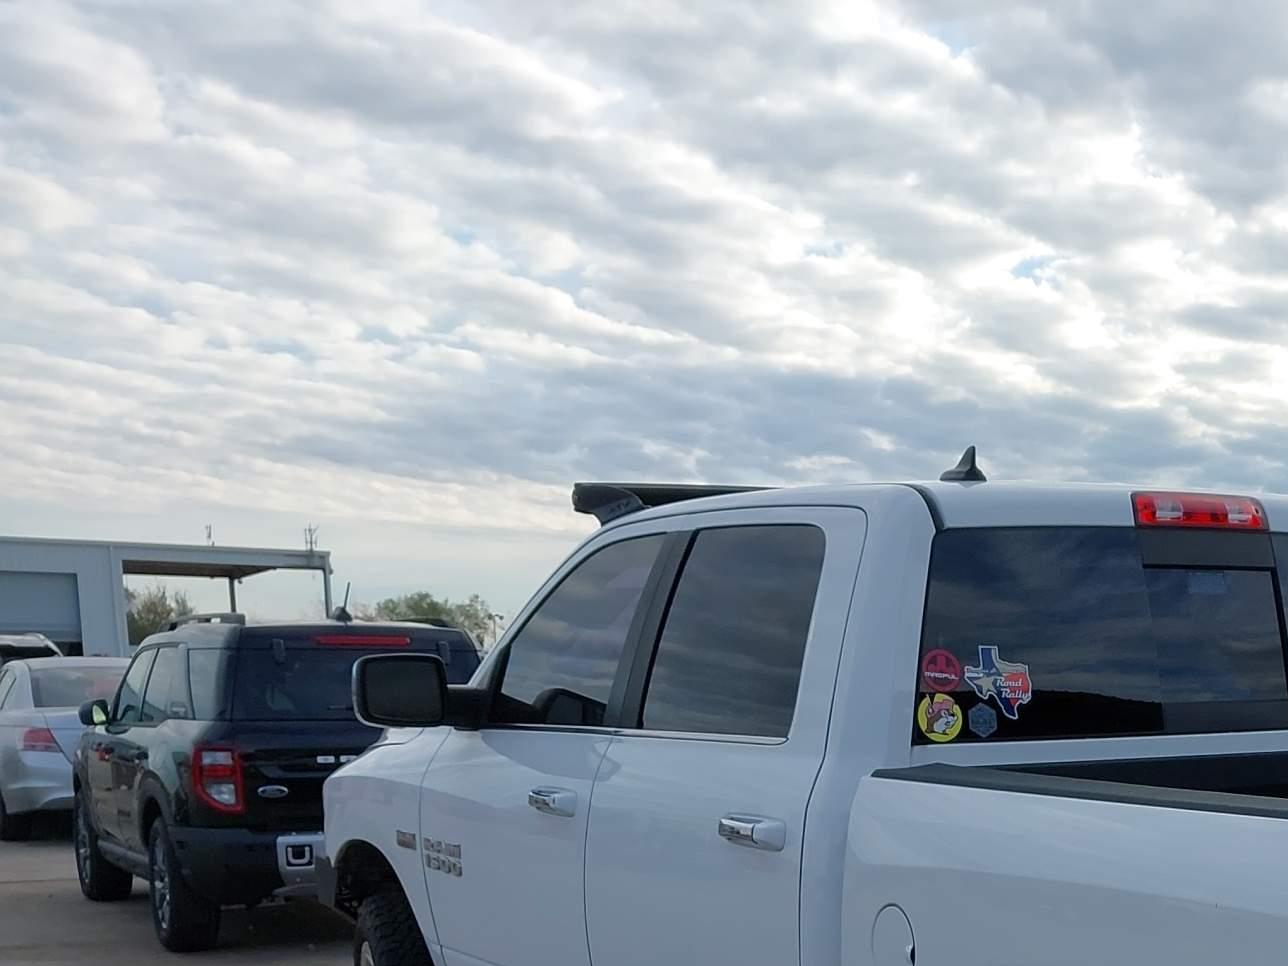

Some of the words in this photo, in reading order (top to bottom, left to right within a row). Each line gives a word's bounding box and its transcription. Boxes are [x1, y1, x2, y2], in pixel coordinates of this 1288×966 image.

[924, 671, 959, 680] MAGPUL
[996, 677, 1024, 688] Road
[1001, 688, 1030, 701] Rally
